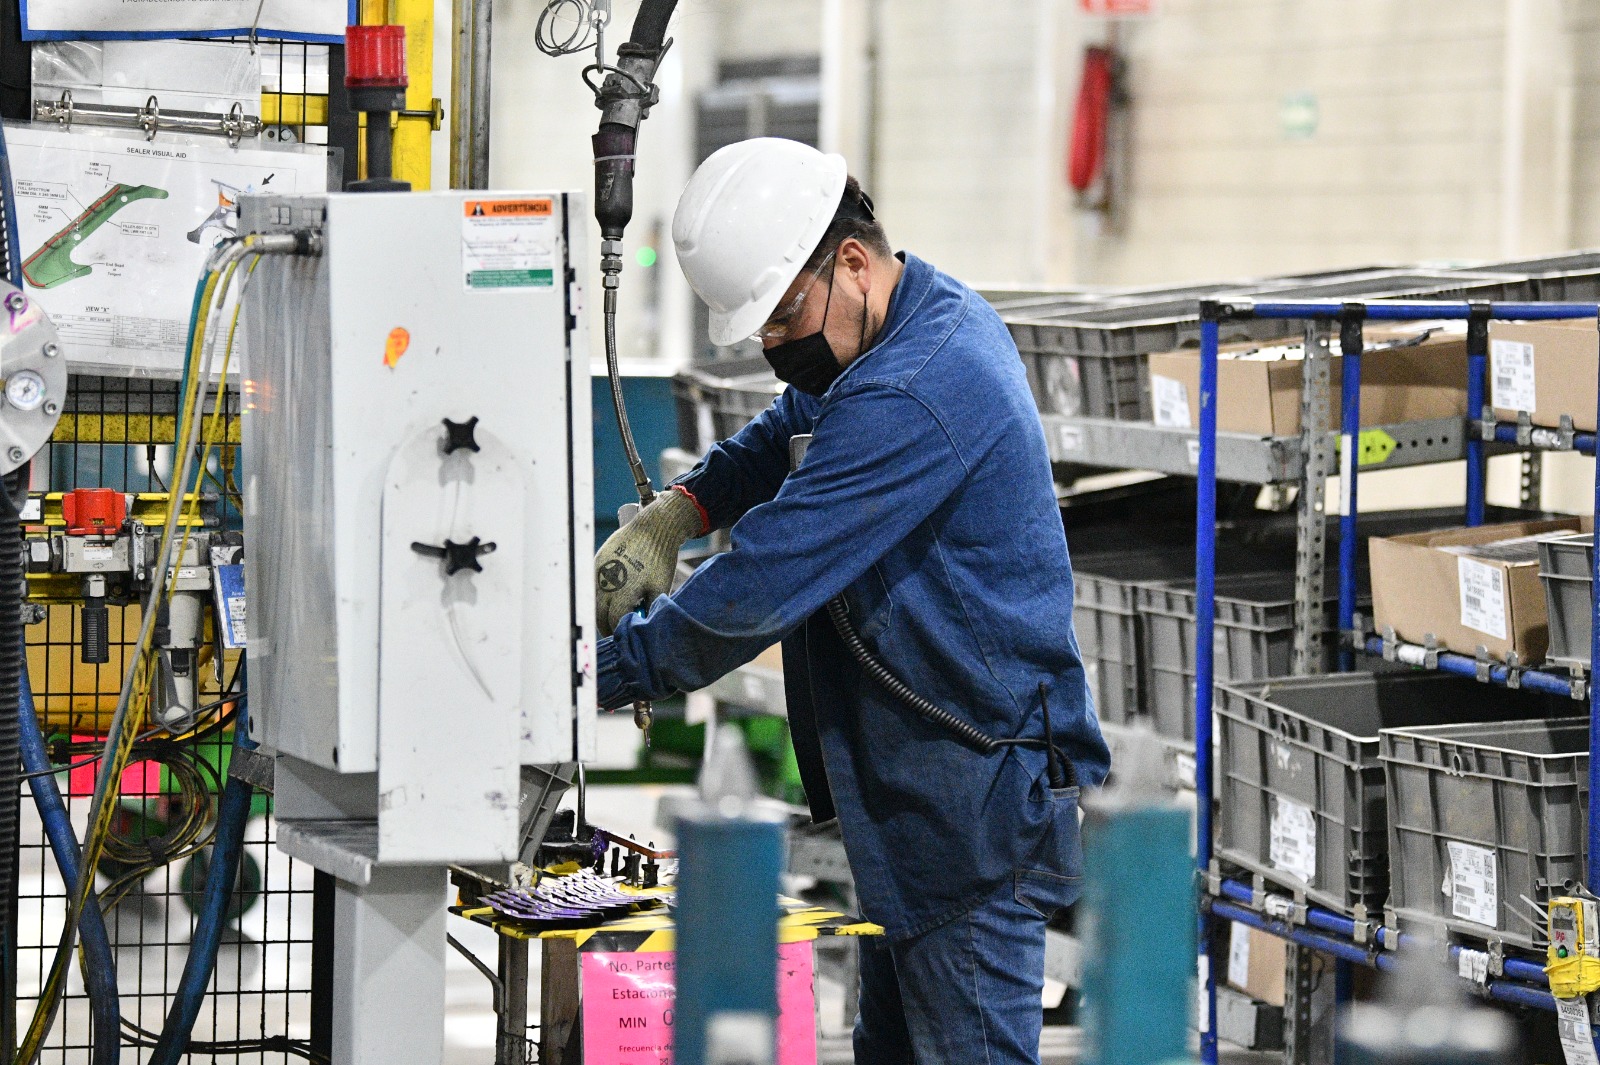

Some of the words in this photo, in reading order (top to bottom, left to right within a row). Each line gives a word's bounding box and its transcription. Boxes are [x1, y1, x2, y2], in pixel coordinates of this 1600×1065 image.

[127, 147, 150, 155] SEALER
[492, 203, 548, 212] ADVERTENCIA
[609, 961, 632, 972] No.
[619, 1017, 647, 1028] MIN
